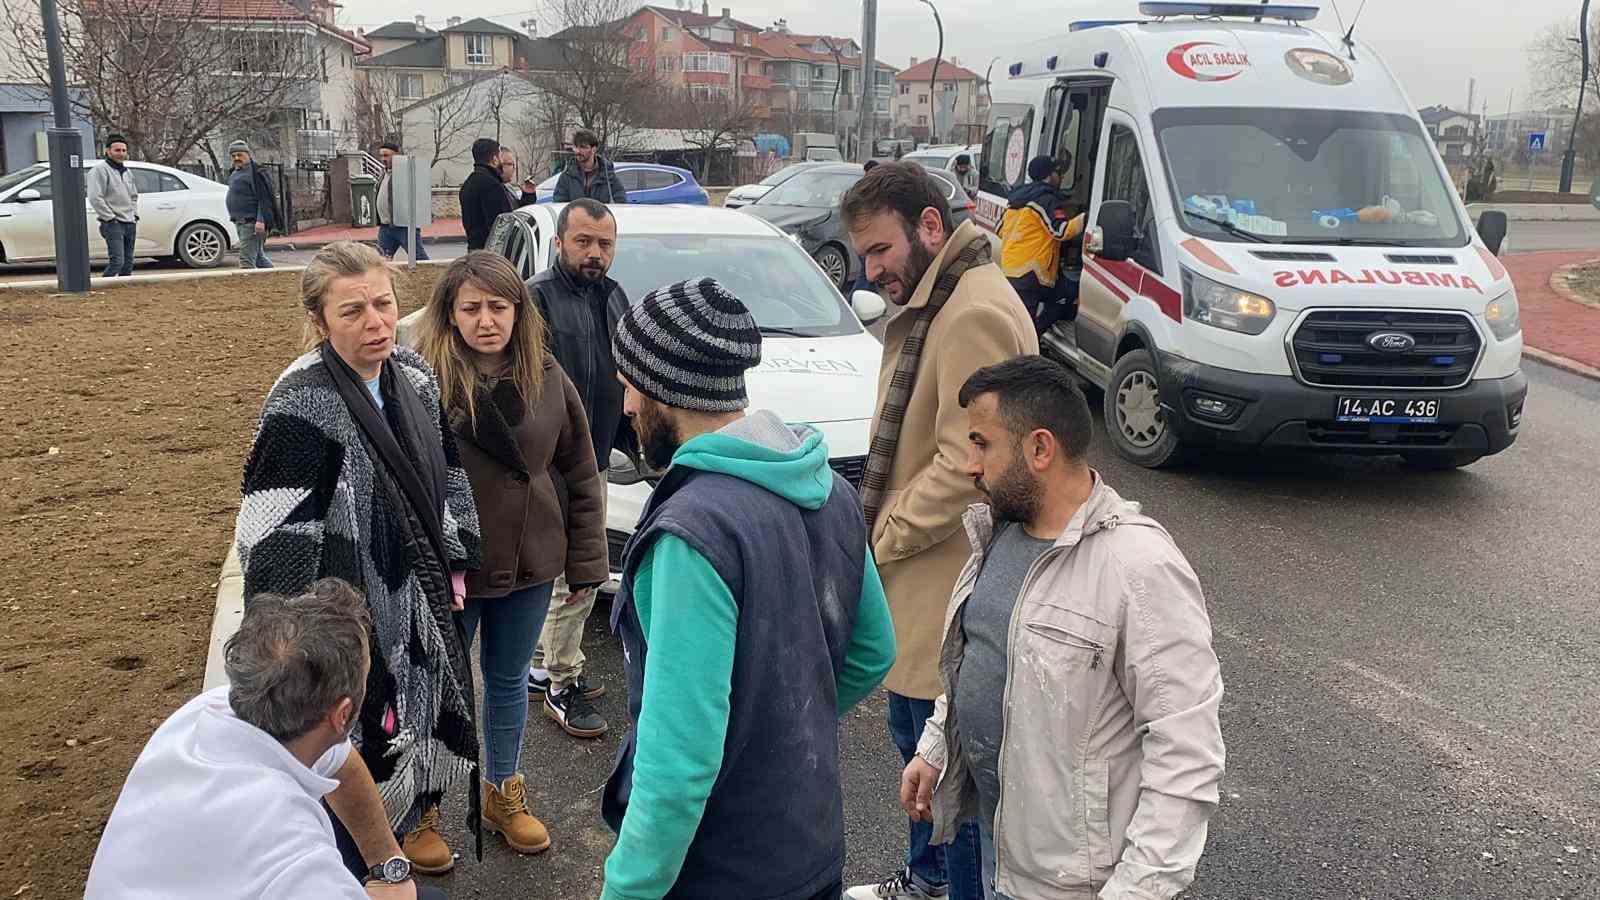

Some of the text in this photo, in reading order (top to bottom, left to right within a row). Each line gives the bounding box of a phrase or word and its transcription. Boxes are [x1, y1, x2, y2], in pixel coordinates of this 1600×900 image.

[1382, 336, 1406, 347] Ford
[1343, 399, 1436, 416] 14 AC 436
